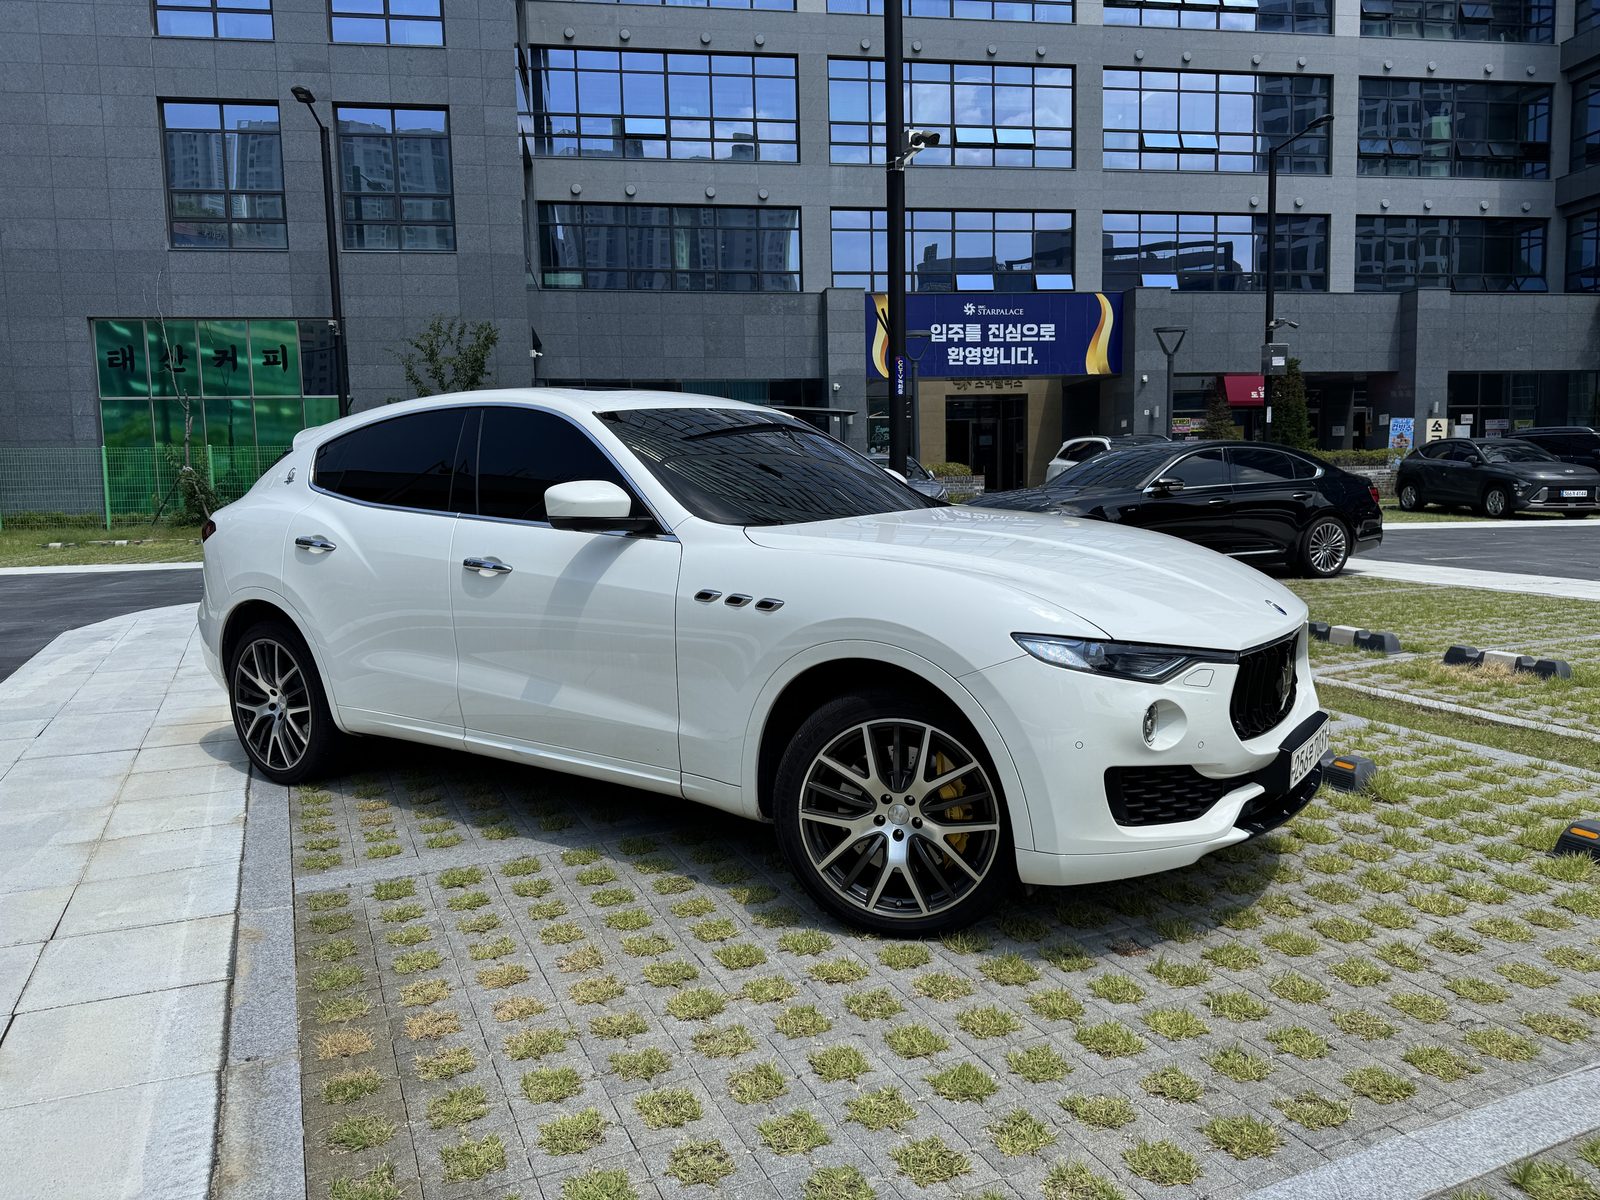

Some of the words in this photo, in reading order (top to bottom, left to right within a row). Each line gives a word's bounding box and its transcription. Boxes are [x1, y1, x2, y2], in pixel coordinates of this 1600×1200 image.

[978, 308, 1024, 316] STARPALACE
[931, 324, 982, 342] 입주를
[988, 323, 1056, 342] 진심으로
[947, 346, 1039, 365] 환영합니다.
